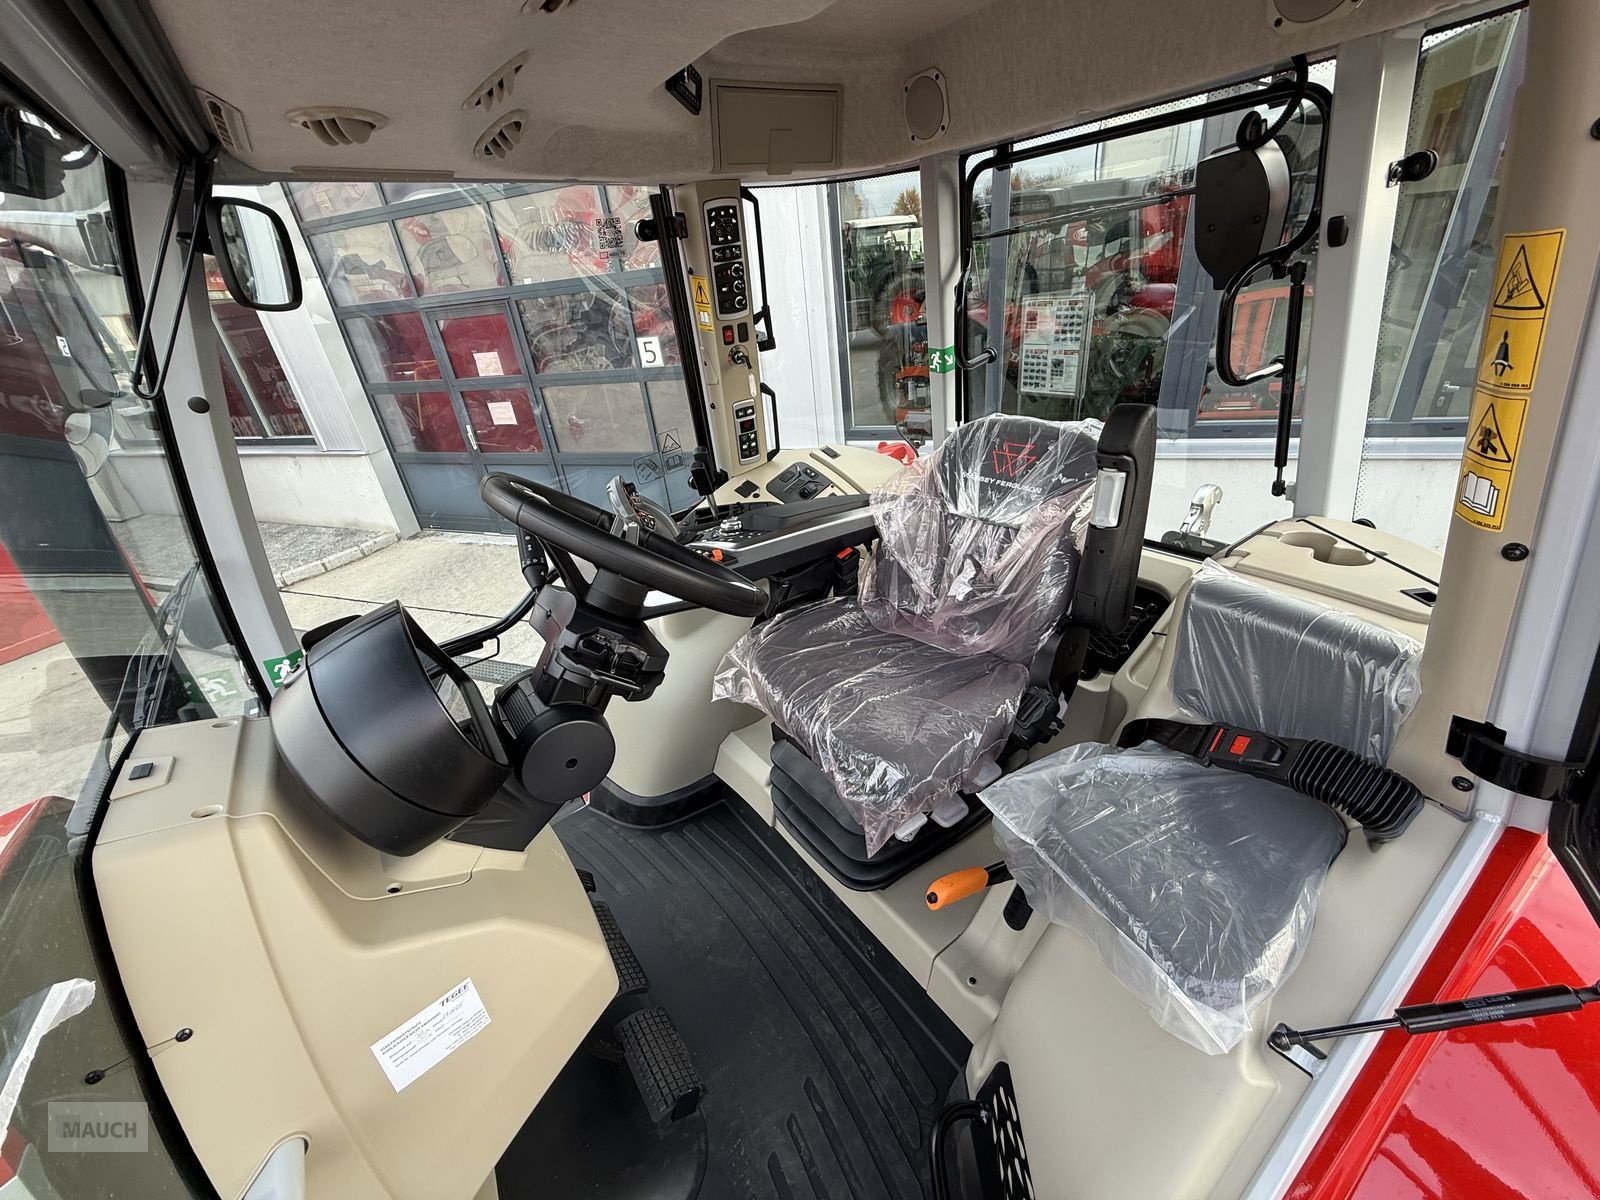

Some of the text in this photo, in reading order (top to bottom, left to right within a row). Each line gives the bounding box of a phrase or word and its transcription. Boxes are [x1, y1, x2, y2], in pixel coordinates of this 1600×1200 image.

[643, 341, 656, 363] 5
[996, 479, 1042, 494] FERGUSON
[440, 982, 470, 1007] TEGEE
